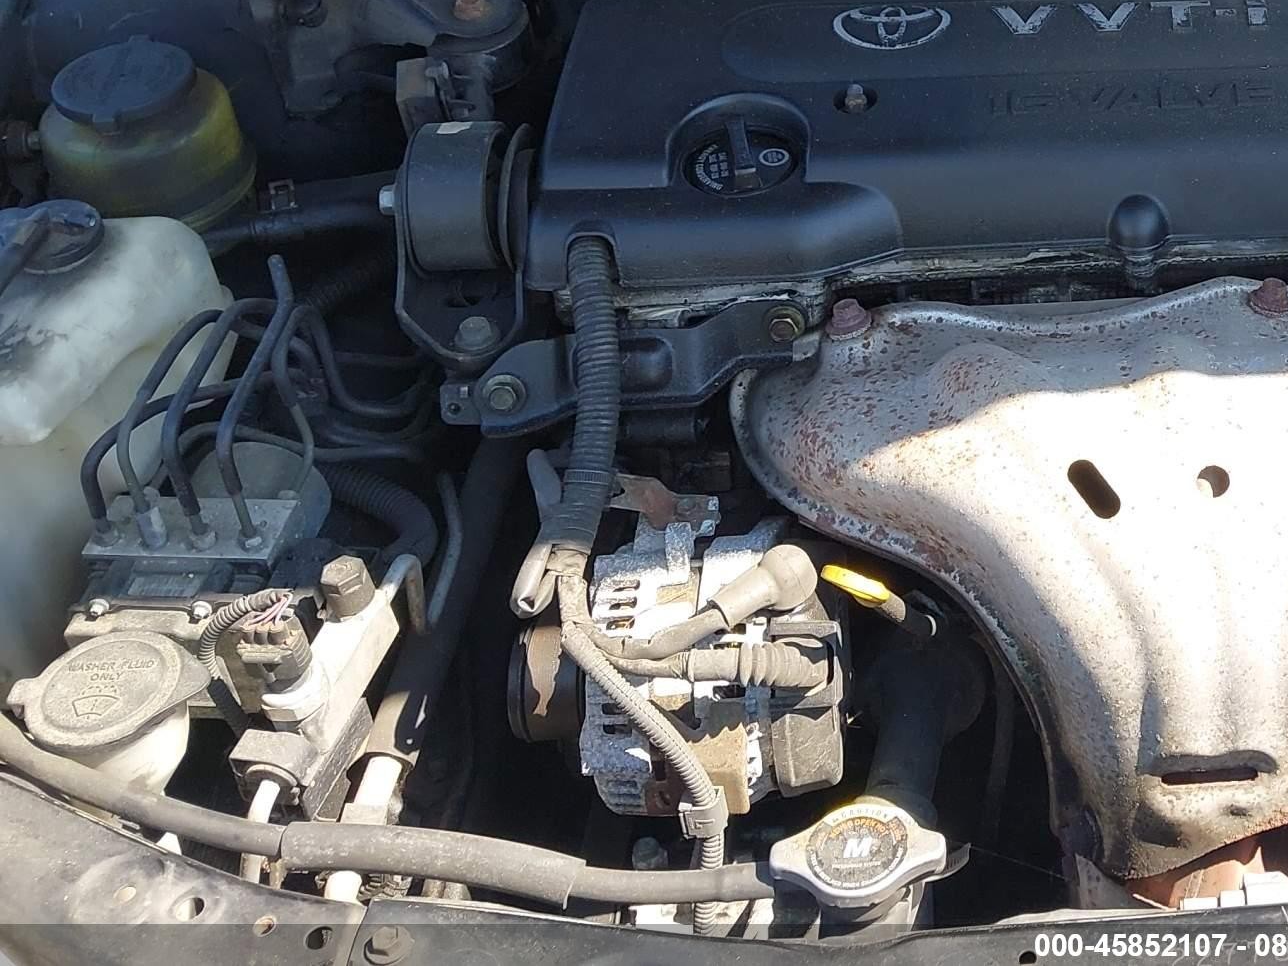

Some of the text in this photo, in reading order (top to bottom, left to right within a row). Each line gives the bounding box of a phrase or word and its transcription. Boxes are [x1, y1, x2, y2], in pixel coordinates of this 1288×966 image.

[991, 0, 1270, 35] VVT-i
[988, 78, 1276, 117] 16 VALVE
[68, 658, 157, 672] WASHER FLUID
[90, 671, 124, 682] ONLY
[854, 817, 877, 830] OPEN
